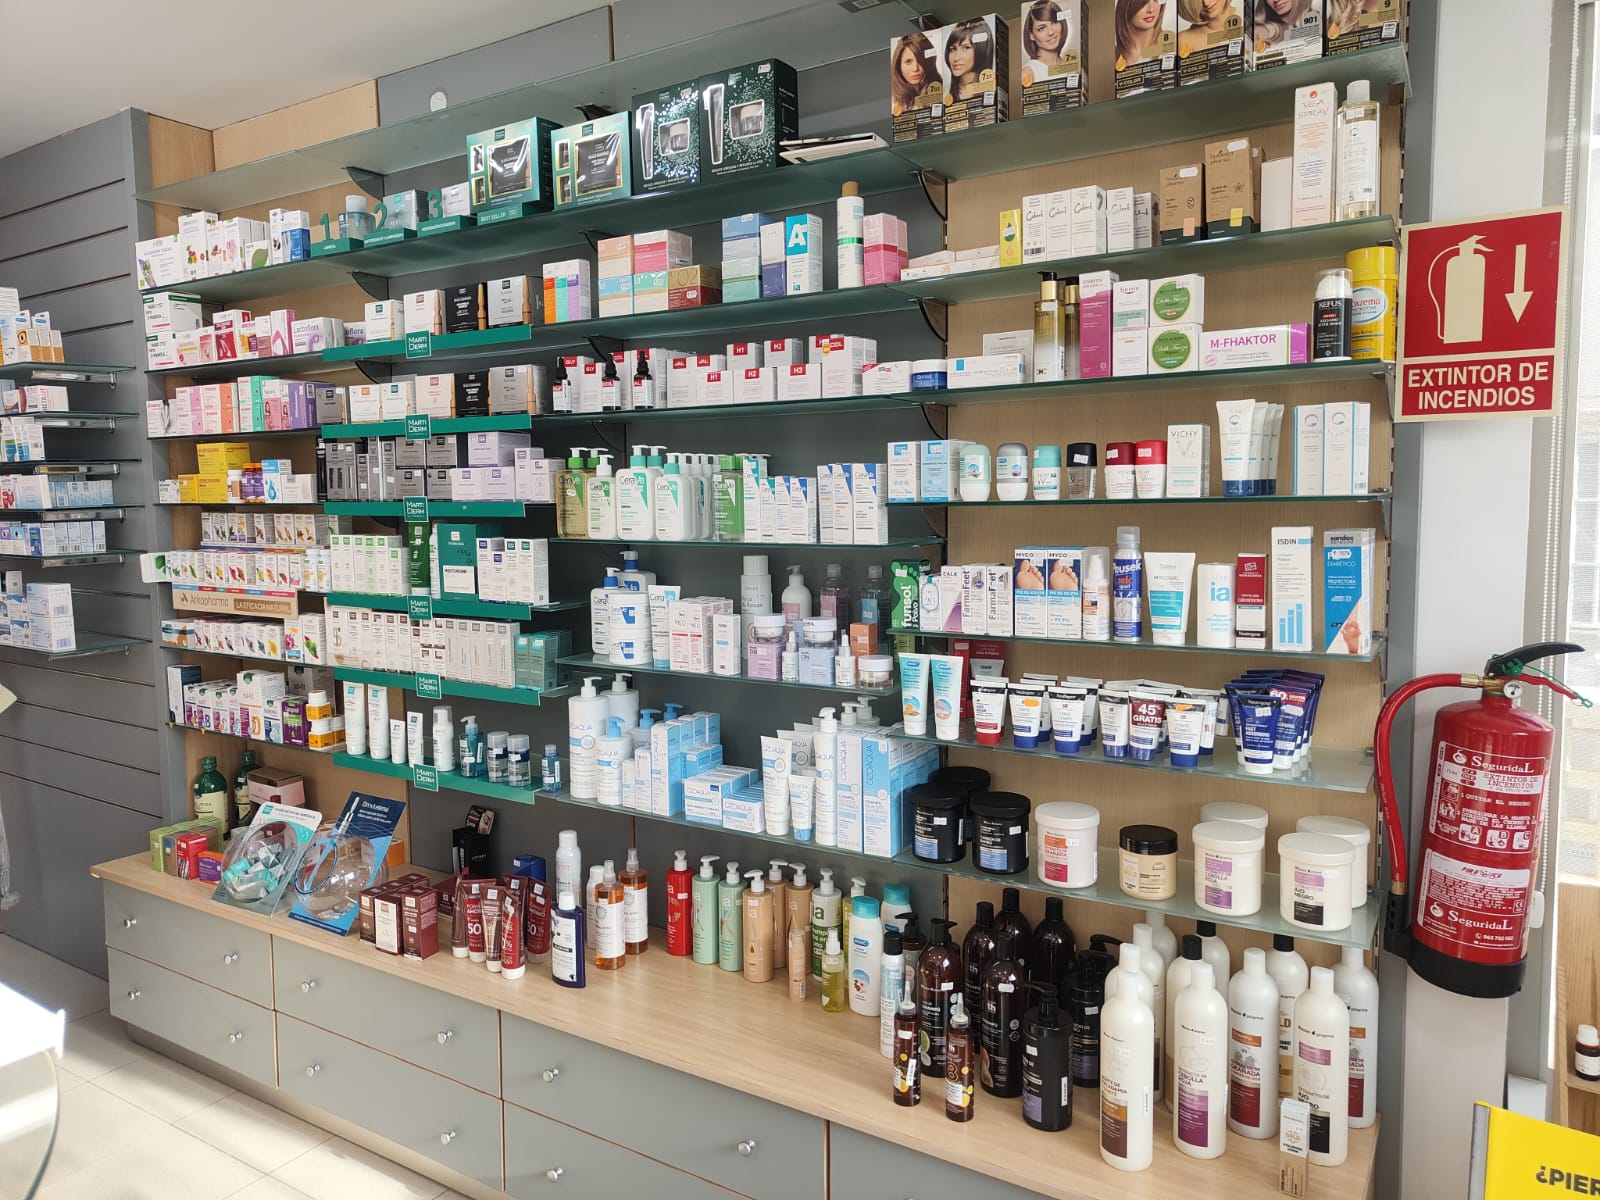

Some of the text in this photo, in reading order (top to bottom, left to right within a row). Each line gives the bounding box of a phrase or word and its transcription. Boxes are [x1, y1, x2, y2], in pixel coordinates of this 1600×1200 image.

[1226, 19, 1239, 28] 10
[1303, 16, 1318, 24] 901
[1163, 34, 1169, 42] 8
[1182, 64, 1208, 74] V-COLOR
[1118, 77, 1142, 86] V-COLOR
[1302, 98, 1325, 108] VEA
[427, 189, 444, 221] 3
[373, 203, 388, 233] 2
[319, 213, 332, 240] 1
[293, 324, 320, 335] Lactoflora
[408, 342, 428, 350] DERM
[1210, 333, 1276, 349] M-FHAKTOR
[793, 366, 803, 374] H3
[1408, 361, 1549, 388] EXTINTOR DE
[1418, 386, 1536, 410] INCENDIOS
[408, 425, 428, 433] DERM
[1170, 430, 1198, 438] VICHY
[559, 475, 581, 485] CeraVe
[620, 476, 645, 486] CeraVe
[590, 483, 609, 492] CeraVe
[657, 483, 677, 492] CeraVe
[406, 507, 425, 515] DERM
[962, 570, 970, 618] FarmaFeet
[1210, 581, 1230, 602] ia
[190, 595, 228, 608] Arkopharma
[410, 599, 428, 607] MARTI
[901, 584, 912, 628] funsol
[418, 676, 437, 684] MARTI
[418, 682, 438, 691] DERM
[1133, 715, 1162, 724] GRATIS
[865, 744, 873, 785] OZOAQUA
[1471, 755, 1535, 774] SeguridaL
[416, 767, 434, 776] MARTI
[416, 773, 435, 784] DERM
[724, 801, 752, 813] OZOAQUA
[1472, 827, 1480, 835] A
[1501, 831, 1508, 839] B
[1524, 831, 1530, 839] C
[1294, 893, 1314, 901] NEGRO
[1447, 910, 1513, 930] SeguridaL
[467, 923, 482, 935] 50
[987, 1002, 996, 1014] th
[1231, 1063, 1260, 1077] GRANADA
[1179, 1070, 1204, 1084] CEBOLLA
[1298, 1092, 1309, 1100] AJO
